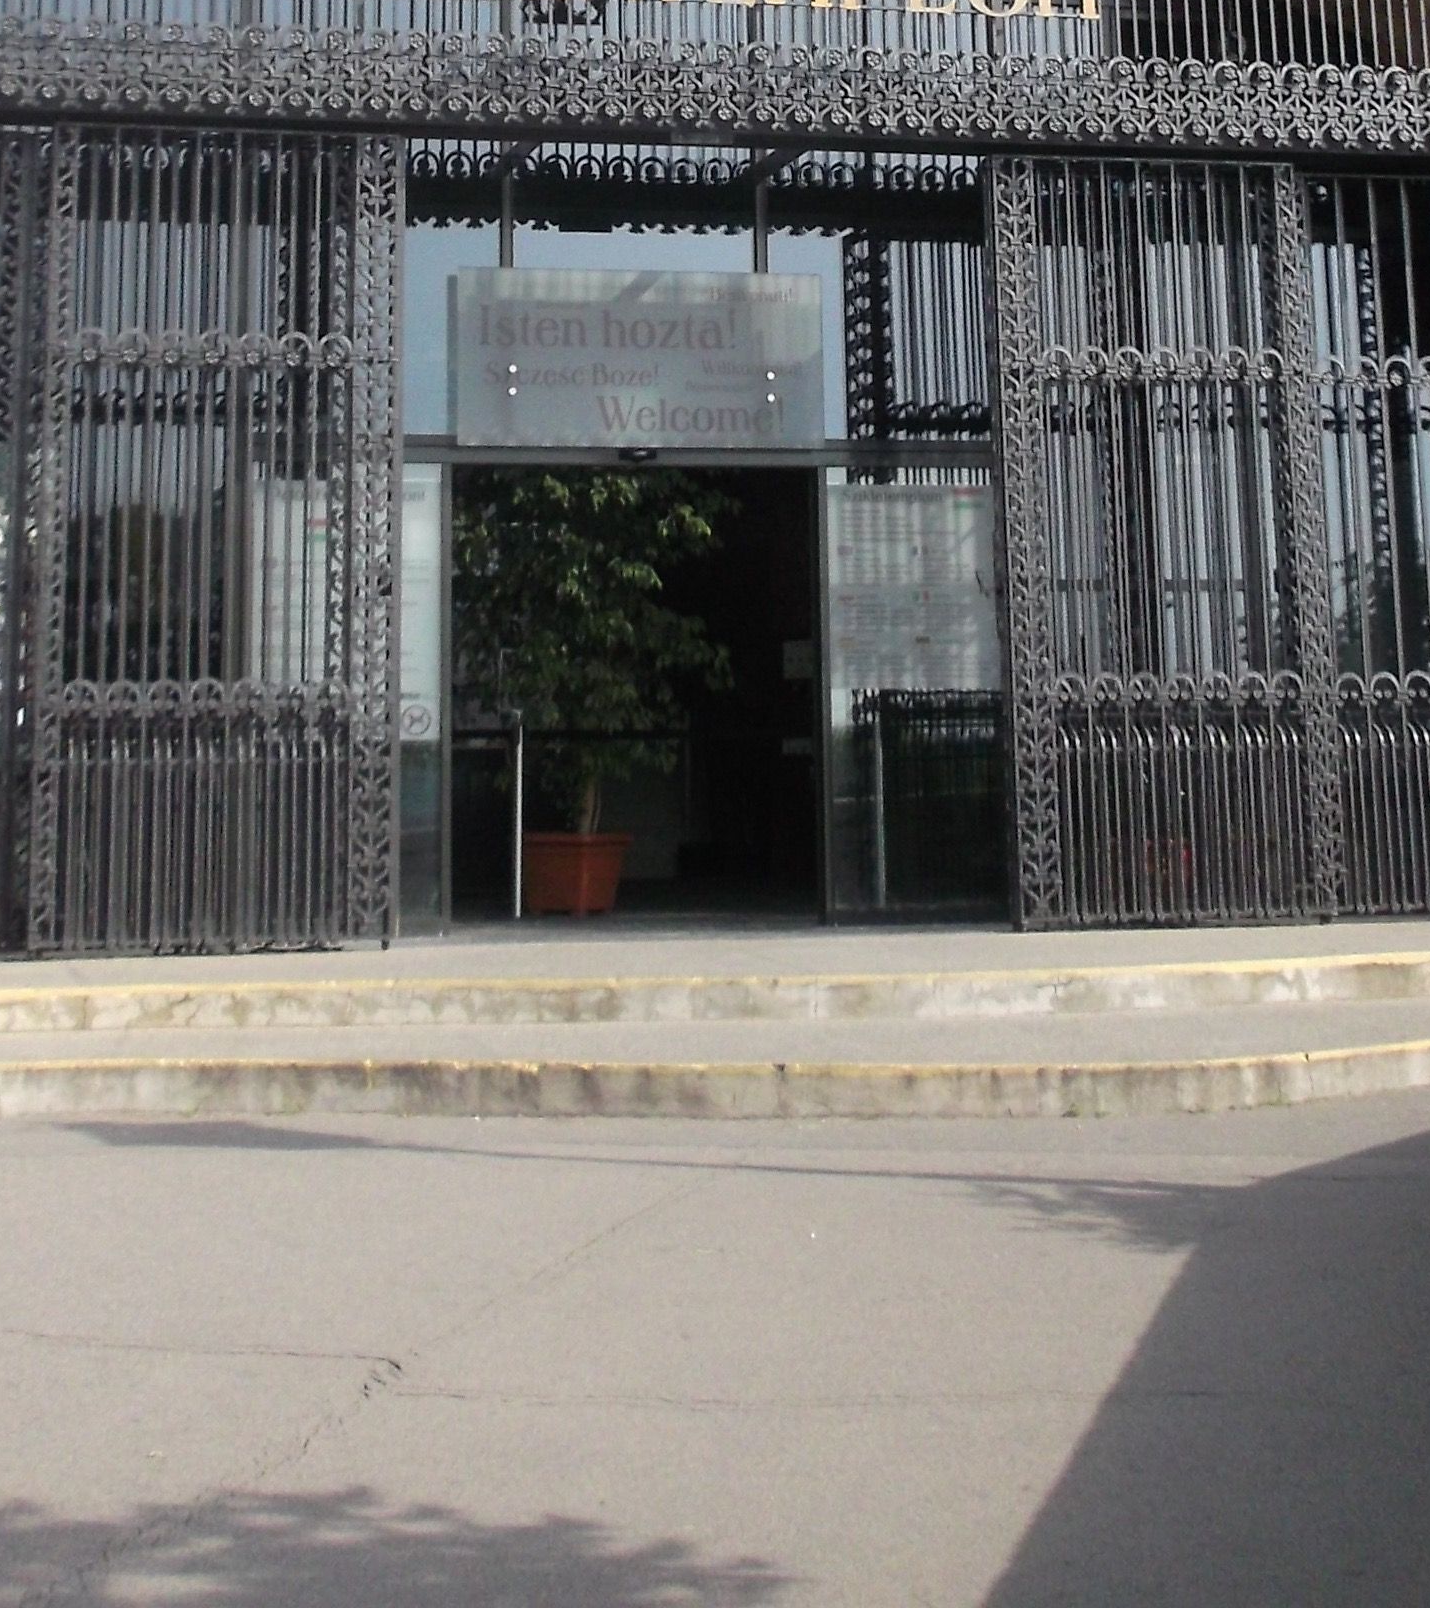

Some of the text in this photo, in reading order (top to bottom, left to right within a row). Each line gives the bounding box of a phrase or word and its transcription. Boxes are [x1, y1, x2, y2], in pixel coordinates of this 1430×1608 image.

[478, 304, 737, 350] Isten hozta!
[596, 395, 785, 434] Welcome!
